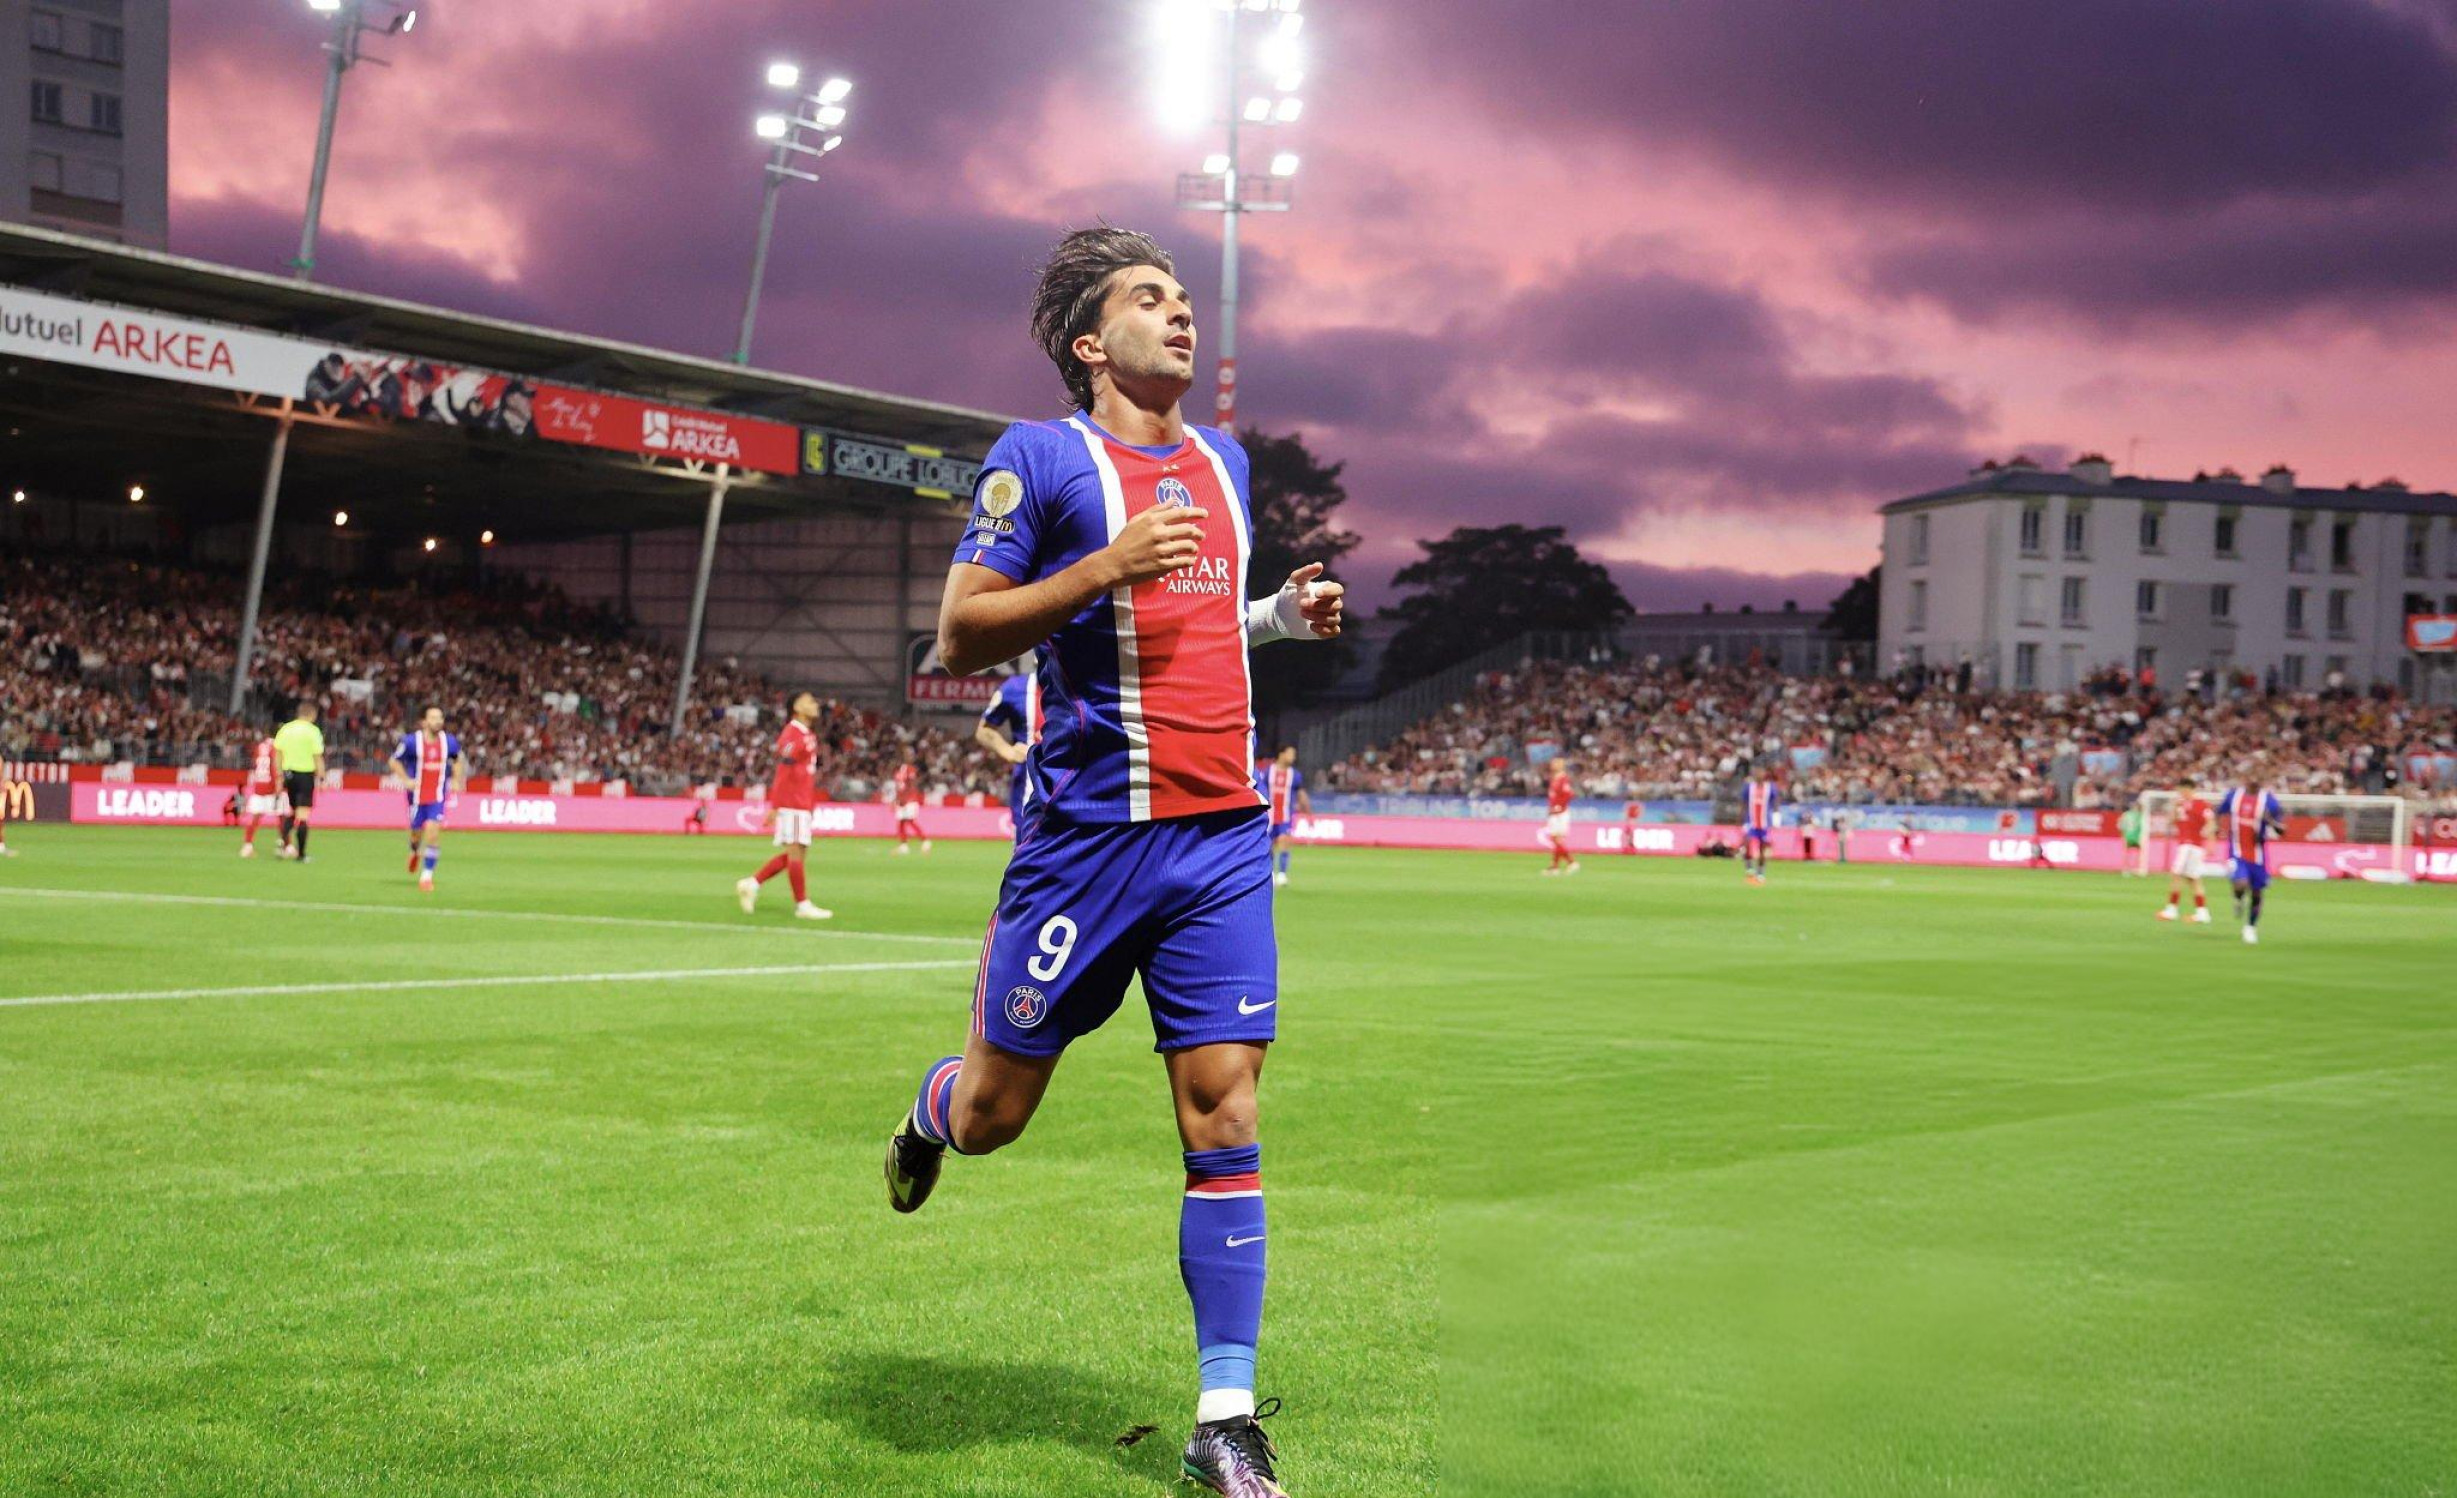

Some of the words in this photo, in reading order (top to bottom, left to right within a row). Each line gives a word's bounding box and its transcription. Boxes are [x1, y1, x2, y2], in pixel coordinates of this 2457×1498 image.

[0, 306, 83, 346] utuel
[92, 319, 235, 375] ARKEA
[670, 427, 740, 459] ARKEA
[975, 516, 997, 530] LIGUE
[1166, 578, 1231, 596] AIRWAYS
[97, 788, 195, 817] LEADER
[479, 798, 556, 825] LEADER
[1596, 827, 1674, 850] LEDER
[1027, 914, 1078, 982] 9
[1015, 988, 1042, 1002] PARIS
